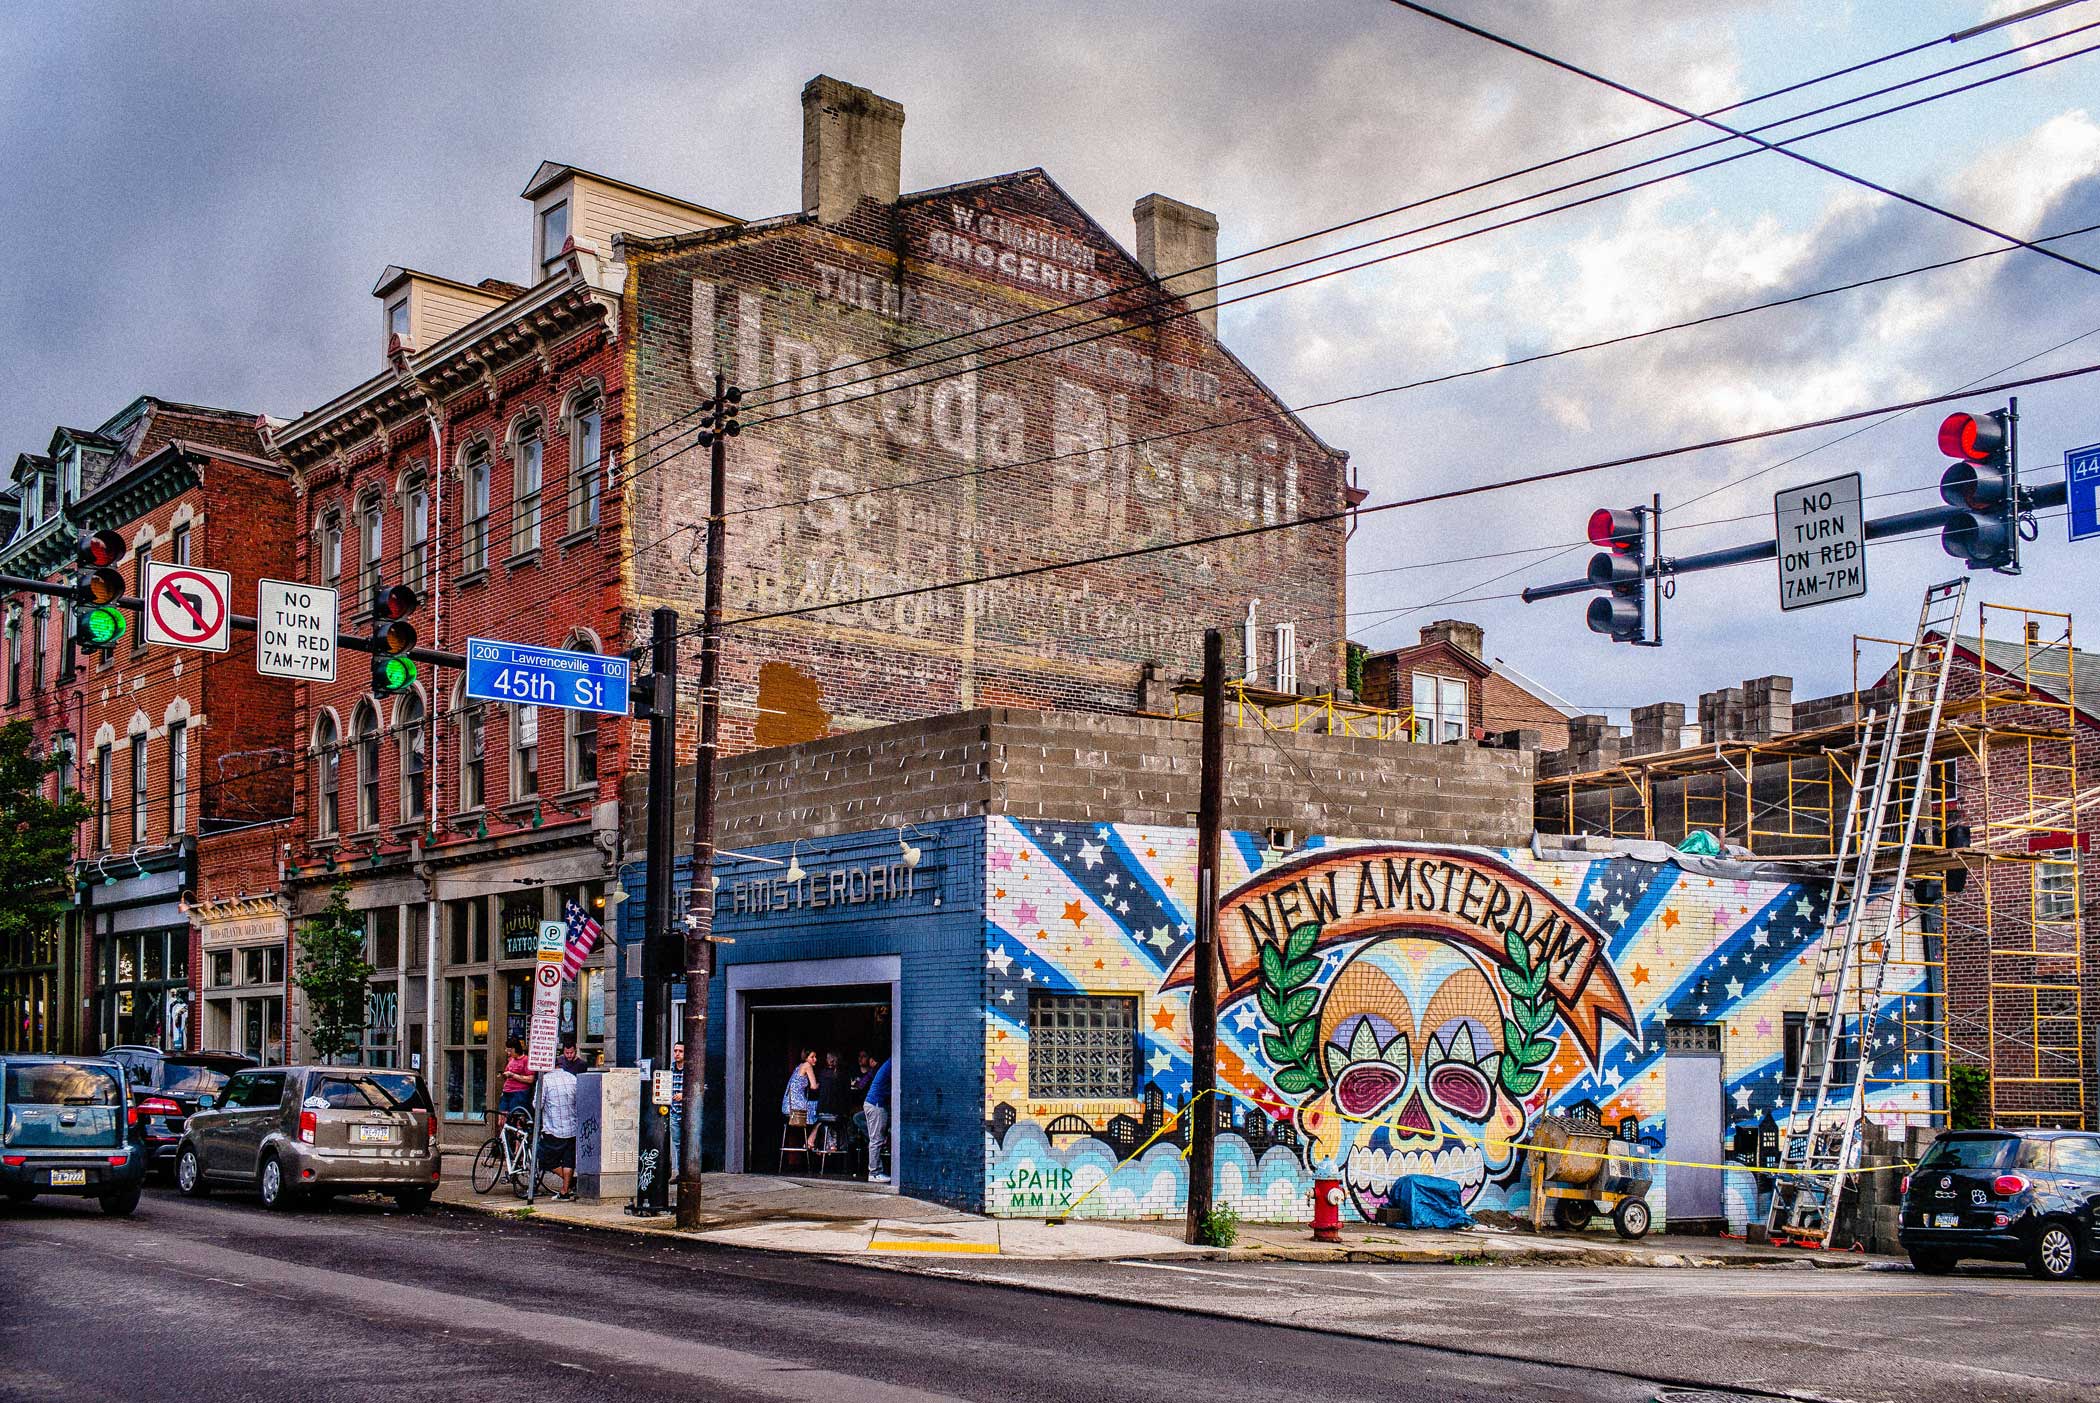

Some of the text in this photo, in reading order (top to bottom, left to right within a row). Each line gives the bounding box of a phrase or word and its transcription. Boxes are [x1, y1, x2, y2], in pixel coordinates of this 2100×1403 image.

[1803, 492, 1832, 515] NO
[1794, 516, 1844, 543] TURN
[1785, 541, 1857, 572] ON RED
[1786, 566, 1859, 598] 7AM-7PM
[285, 592, 311, 608] NO
[276, 611, 320, 630] TURN
[264, 631, 329, 651] ON RED
[264, 651, 330, 672] 7AM-7PM
[476, 646, 622, 676] 200 Lawrenceville 100
[493, 668, 604, 706] 45th St
[732, 864, 913, 914] AMSTERDAM
[1238, 857, 1590, 983] NEW AMSTERDAM
[507, 936, 538, 953] TATTOO
[1006, 1167, 1073, 1191] SPAHR
[1012, 1191, 1072, 1208] MMIX
